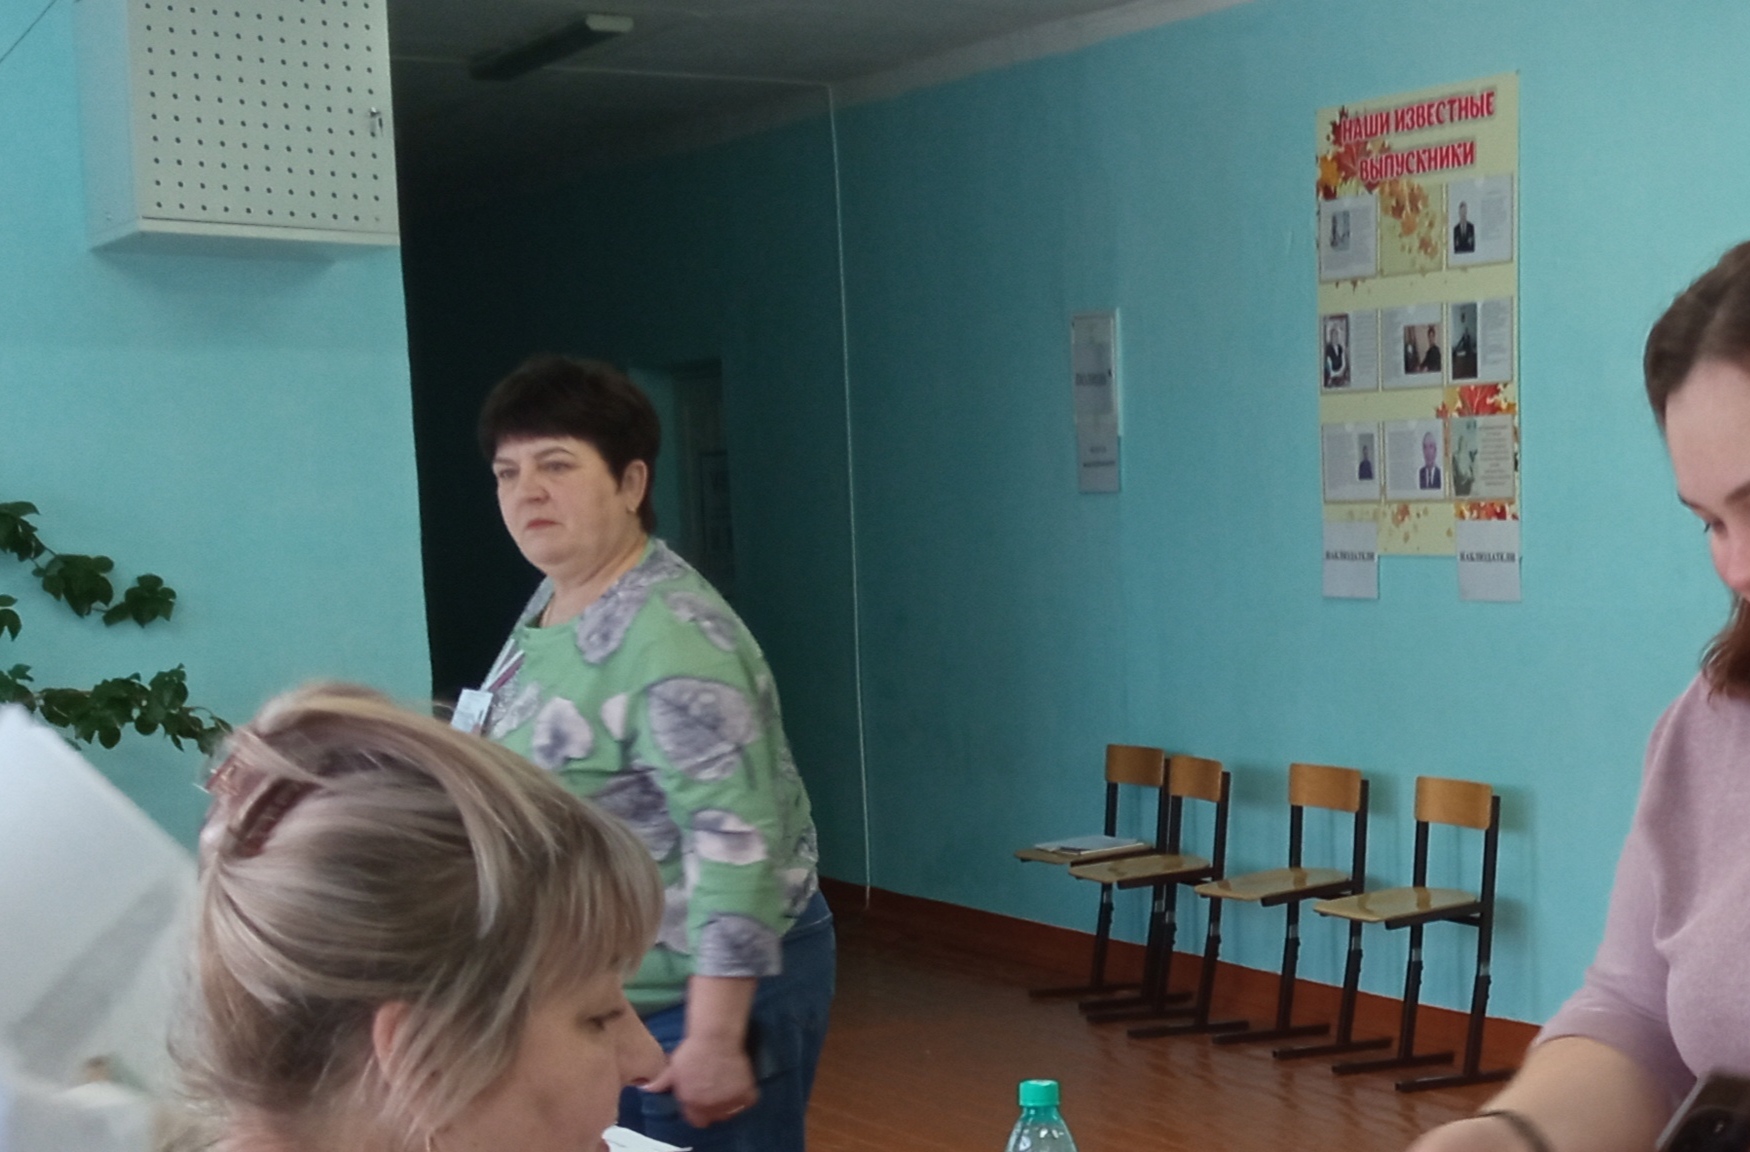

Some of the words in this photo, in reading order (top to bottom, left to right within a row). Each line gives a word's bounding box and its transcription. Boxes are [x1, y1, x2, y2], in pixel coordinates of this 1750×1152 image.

[1341, 111, 1390, 142] НАШИ
[1395, 91, 1495, 132] ИЗВЕСТНЫЕ
[1359, 141, 1475, 182] ВЫПУСКНИКИ
